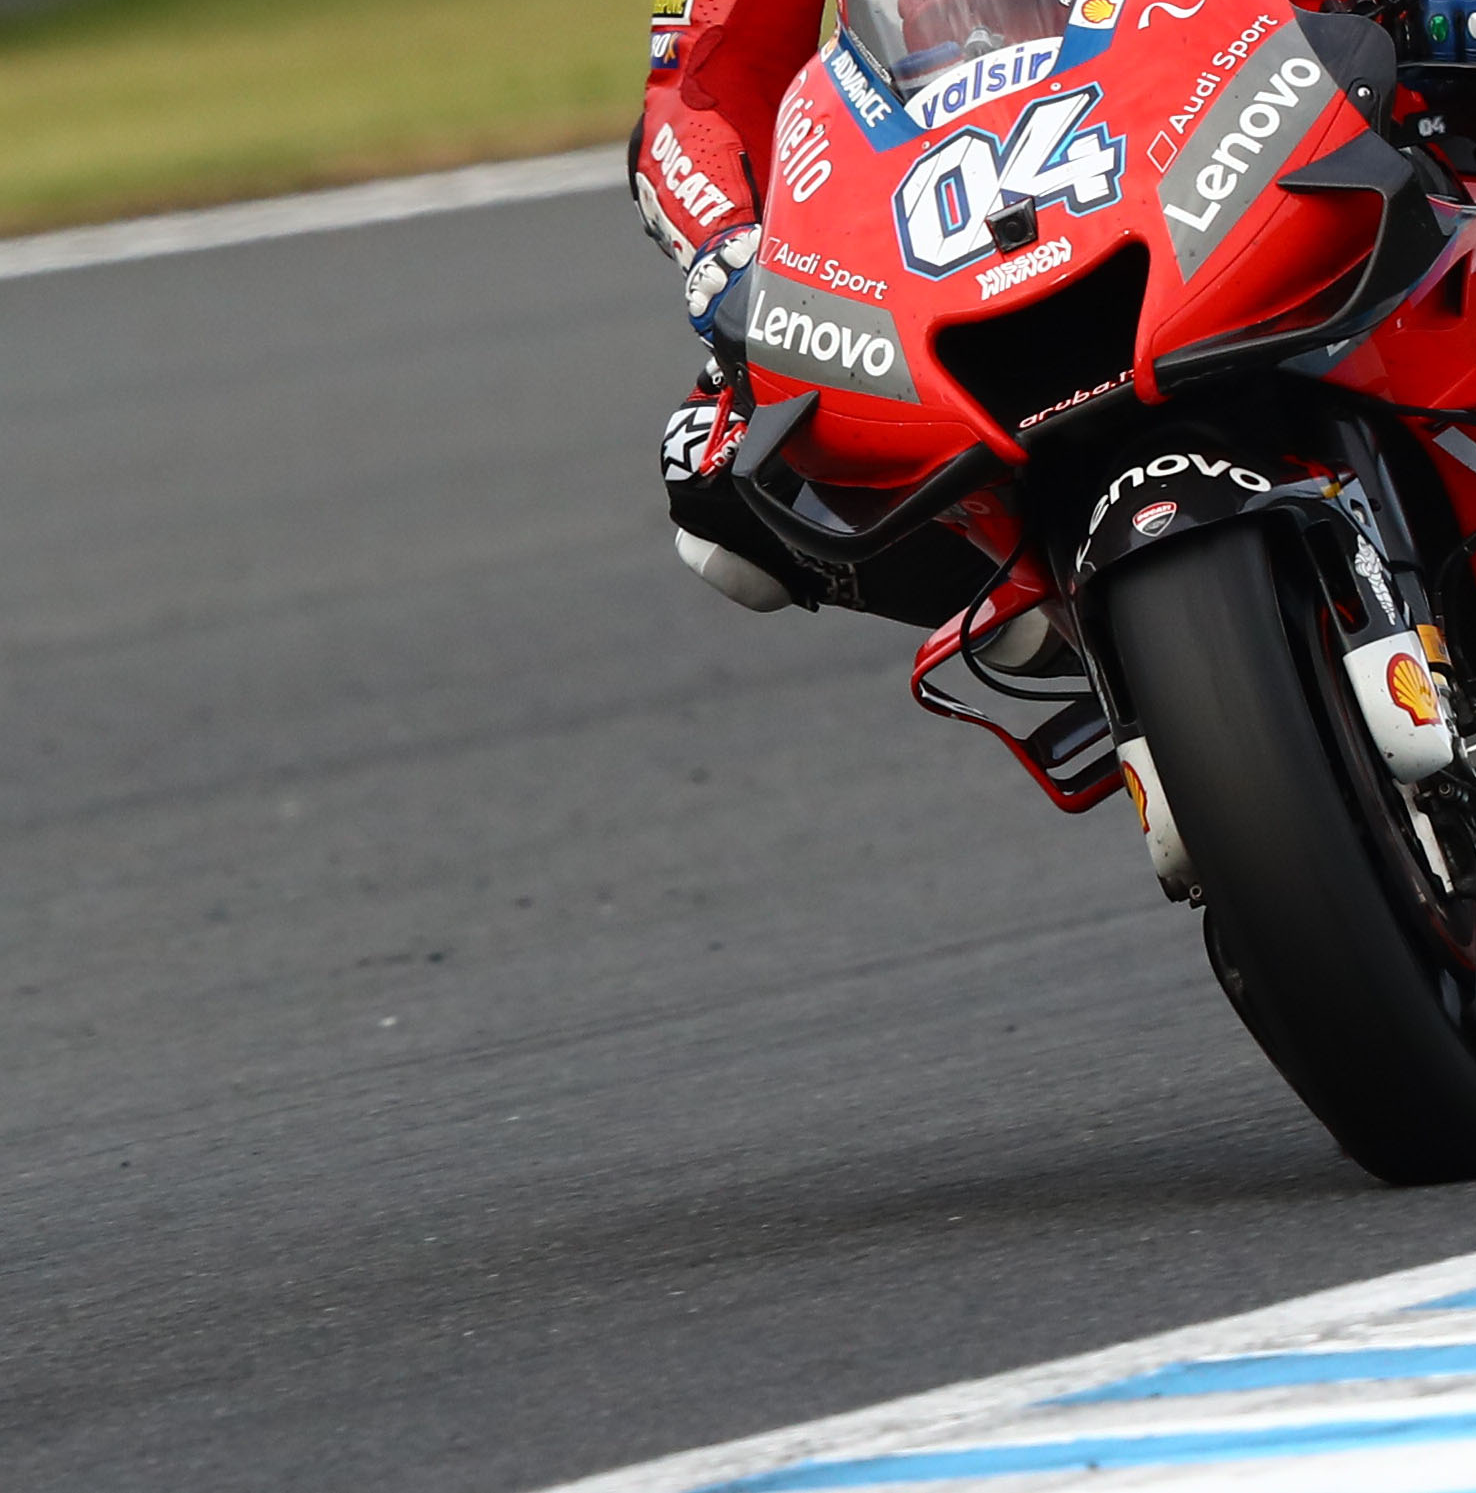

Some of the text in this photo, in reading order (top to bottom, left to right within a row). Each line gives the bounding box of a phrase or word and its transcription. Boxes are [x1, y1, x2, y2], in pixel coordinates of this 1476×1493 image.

[829, 49, 893, 129] ADVANCE
[922, 46, 1054, 129] valsir
[1169, 13, 1279, 134] Audi Sport
[651, 121, 736, 227] DUCATI
[776, 98, 833, 203] riello
[892, 82, 1126, 280] 04
[1163, 57, 1322, 234] Lenovo
[775, 244, 889, 300] Audi Sport
[747, 289, 896, 377] Lenovo
